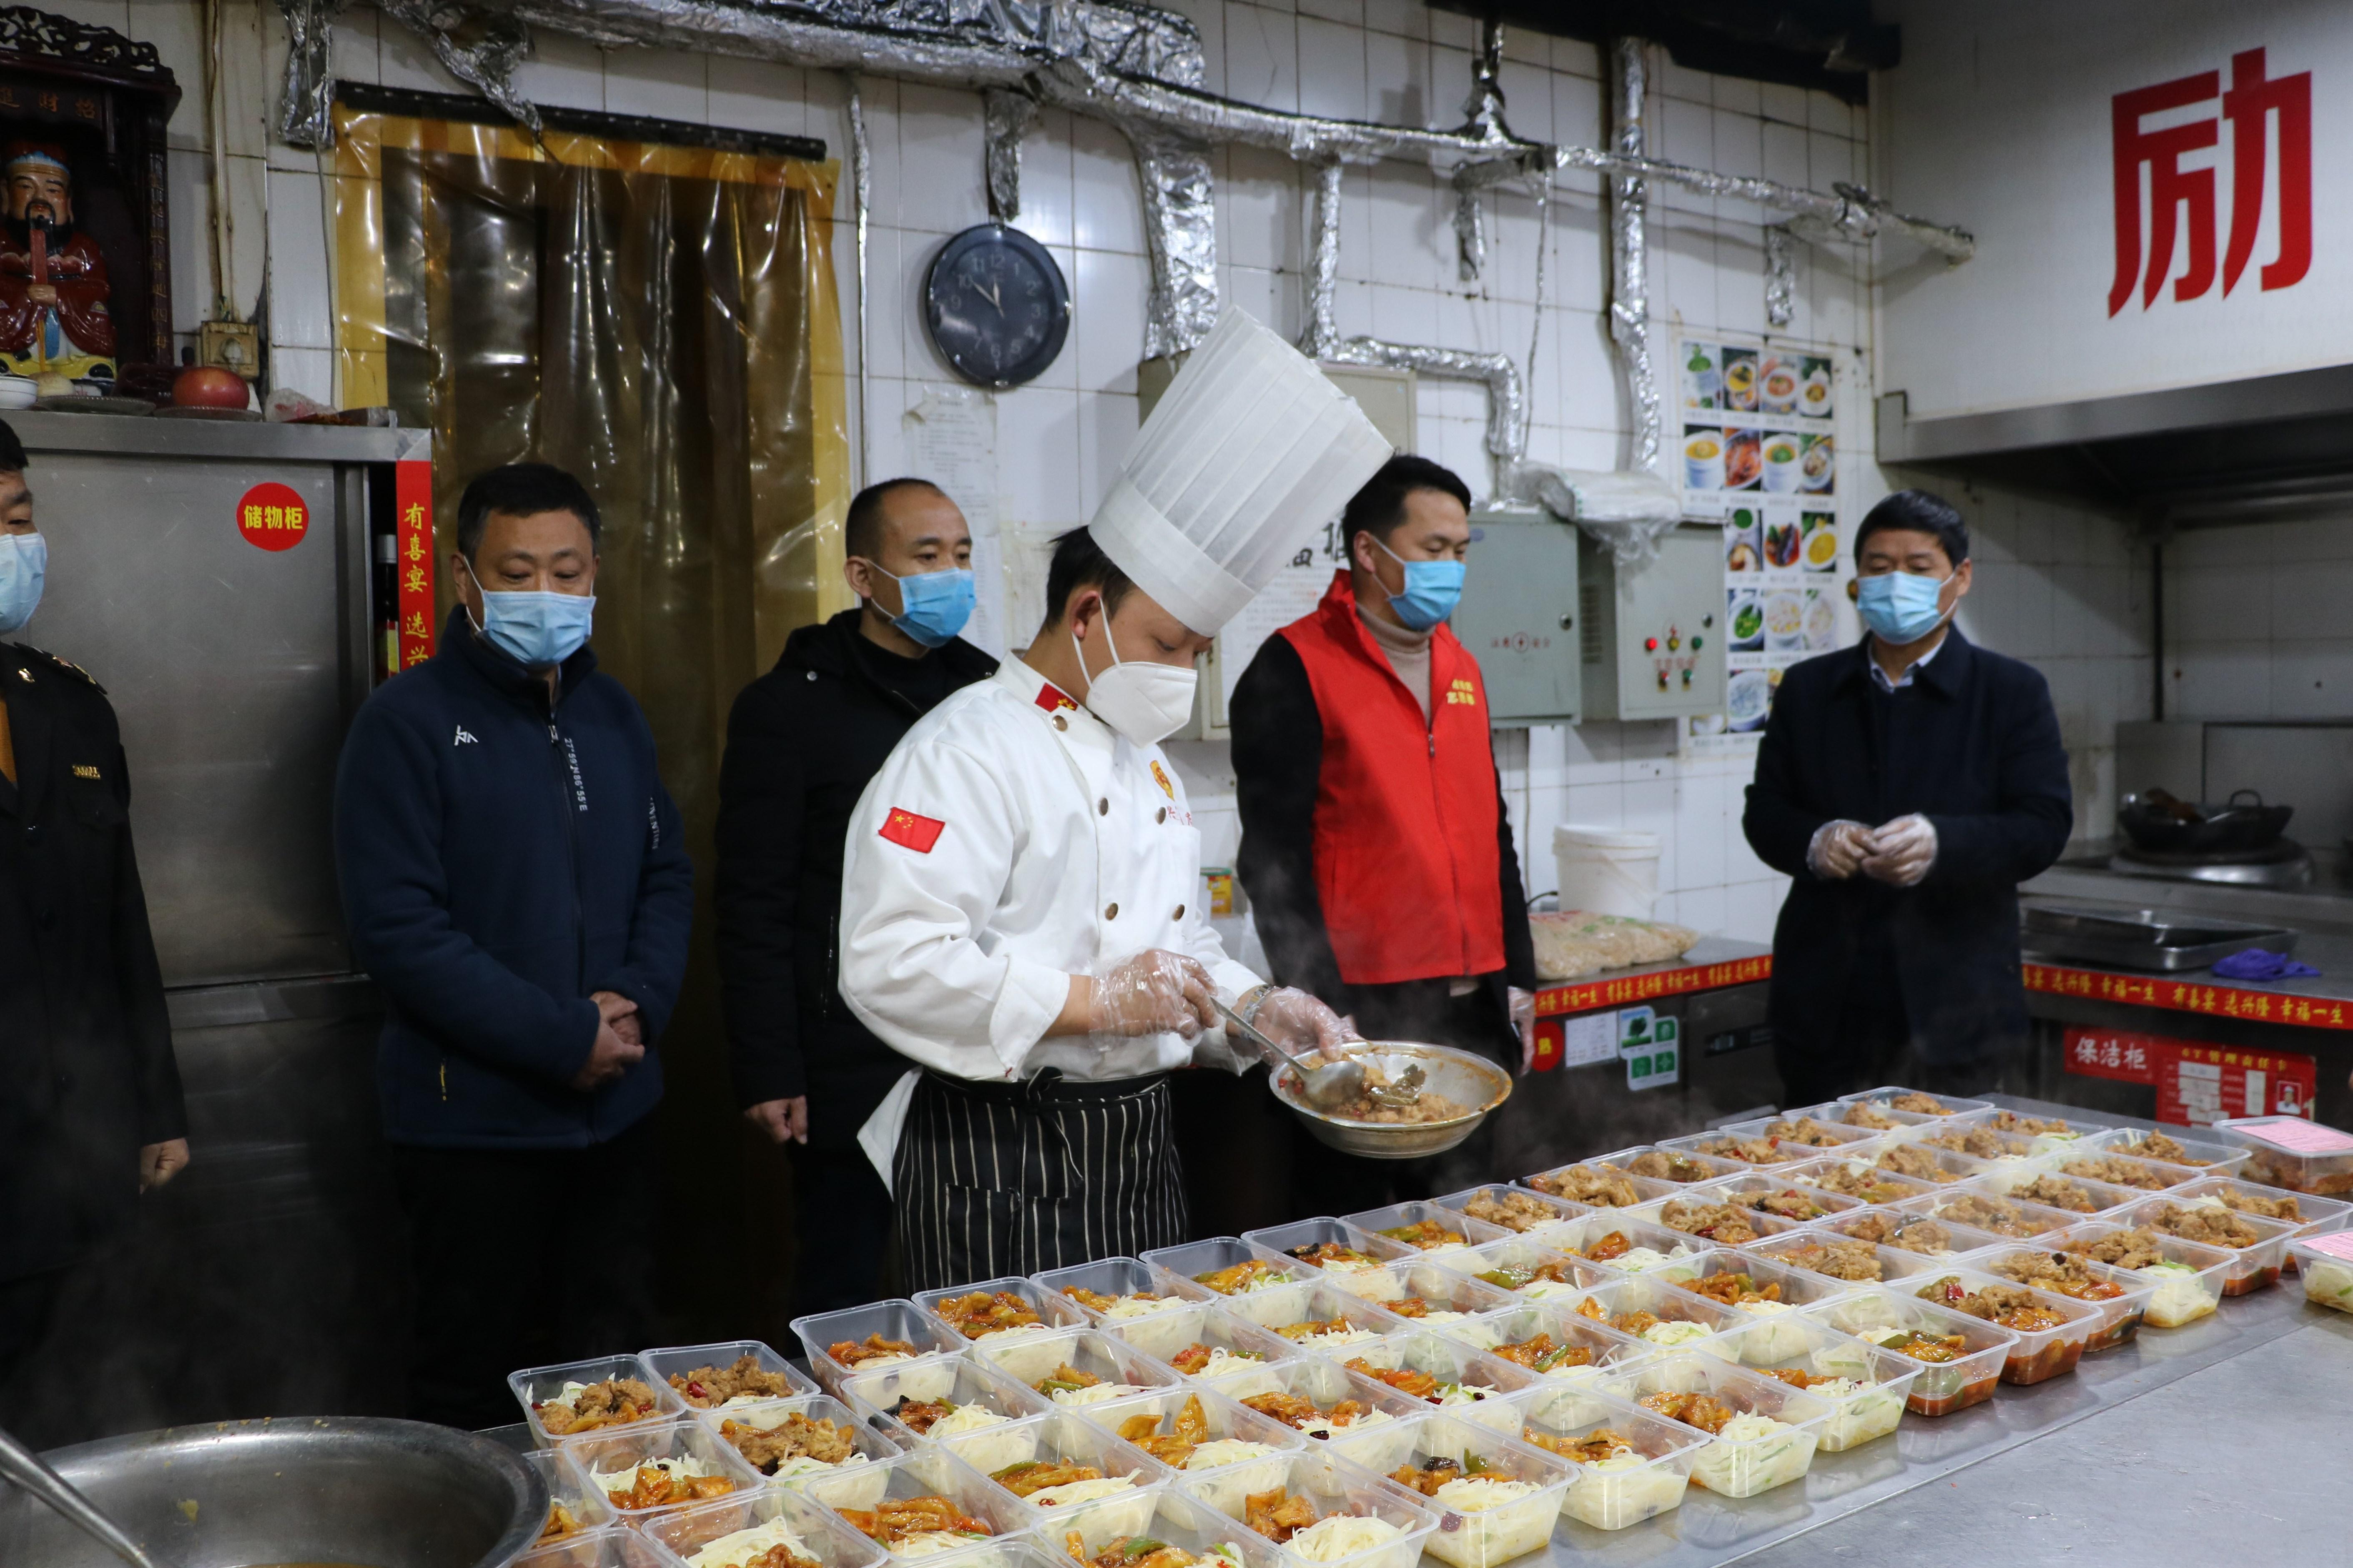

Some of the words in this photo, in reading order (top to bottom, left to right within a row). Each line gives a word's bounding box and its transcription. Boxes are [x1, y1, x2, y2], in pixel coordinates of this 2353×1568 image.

[2108, 46, 2312, 319] 励
[244, 505, 303, 530] 储物柜
[404, 502, 427, 593] 有喜宴
[2074, 1037, 2147, 1070] 保洁柜
